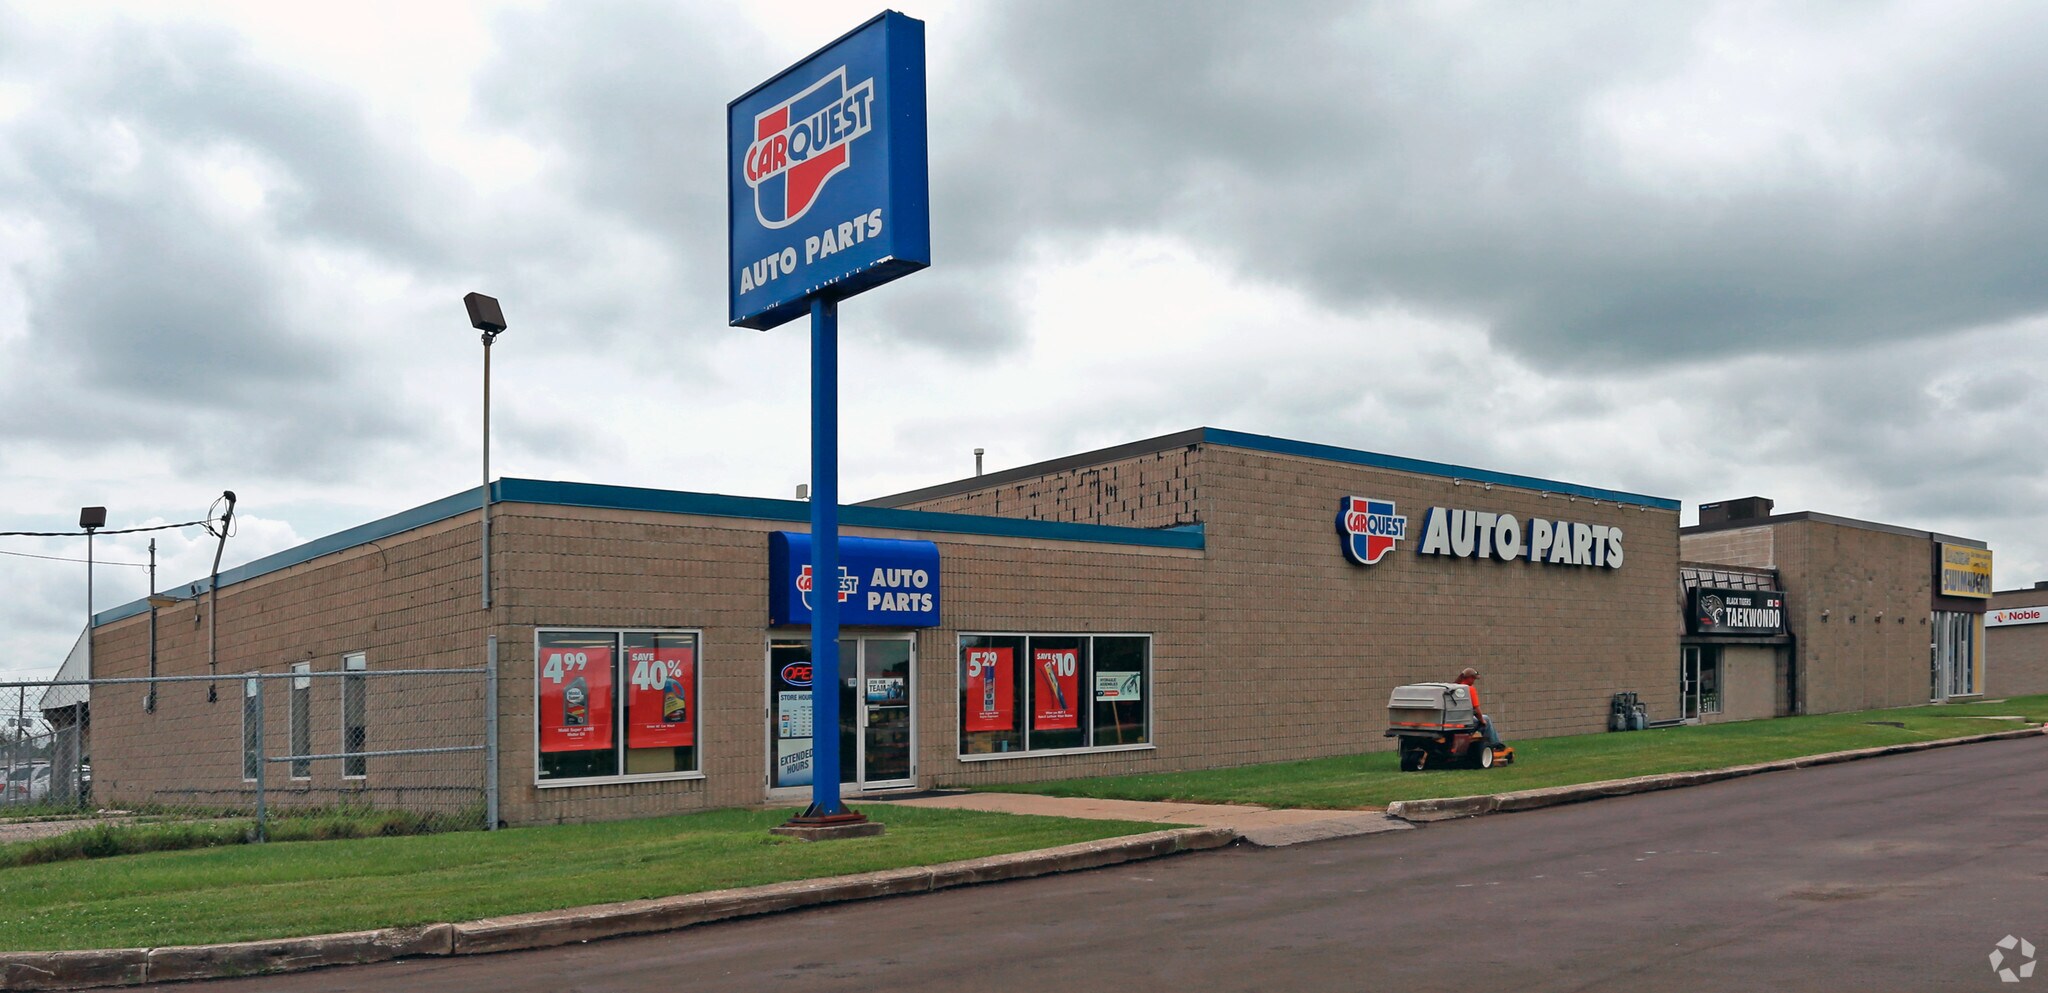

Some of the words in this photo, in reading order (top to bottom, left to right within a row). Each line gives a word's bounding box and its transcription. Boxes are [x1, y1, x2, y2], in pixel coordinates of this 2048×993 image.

[747, 88, 870, 182] CARQUEST
[740, 246, 797, 296] AUTO
[806, 208, 883, 265] PARTS
[1347, 512, 1405, 536] CARQUEST
[1420, 506, 1521, 561] AUTO
[1529, 518, 1624, 569] PARTS
[871, 568, 929, 588] AUTO
[867, 592, 933, 612] PARTS
[1726, 597, 1739, 605] BLACK
[1739, 598, 1752, 606] TIGERS
[1726, 608, 1780, 628] TAEKWONDO
[2009, 610, 2040, 621] Noble
[632, 653, 654, 661] SAVE
[1052, 653, 1076, 677] $10
[784, 667, 813, 680] OPE
[780, 748, 814, 766] EXTENDED
[787, 760, 809, 774] HOURS
